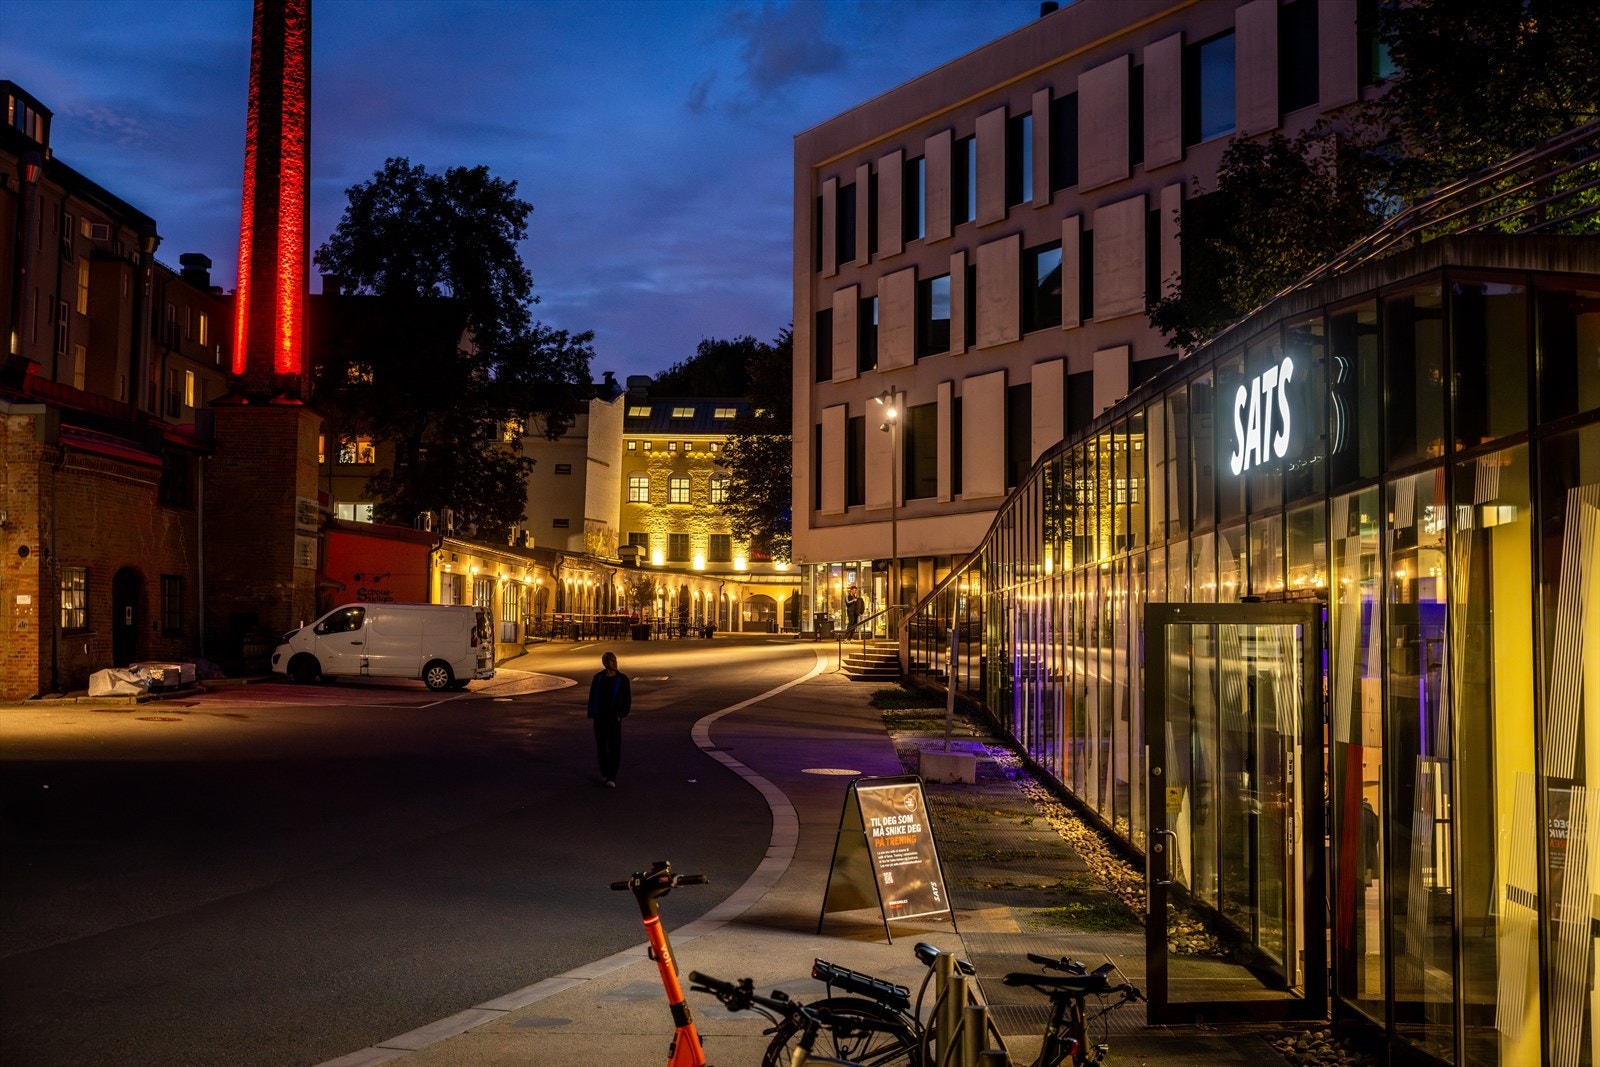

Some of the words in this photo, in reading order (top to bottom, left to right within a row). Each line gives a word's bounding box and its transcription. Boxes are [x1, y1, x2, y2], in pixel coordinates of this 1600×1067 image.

[1230, 356, 1294, 476] SATS
[871, 817, 882, 826] TIL
[883, 817, 897, 826] DEG
[898, 814, 913, 825] SOM
[872, 826, 885, 837] MÅ
[886, 825, 906, 836] SNIKE
[907, 824, 921, 833] DEG
[875, 837, 885, 847] PÅ
[886, 835, 916, 846] TRENING
[930, 881, 941, 902] SATS
